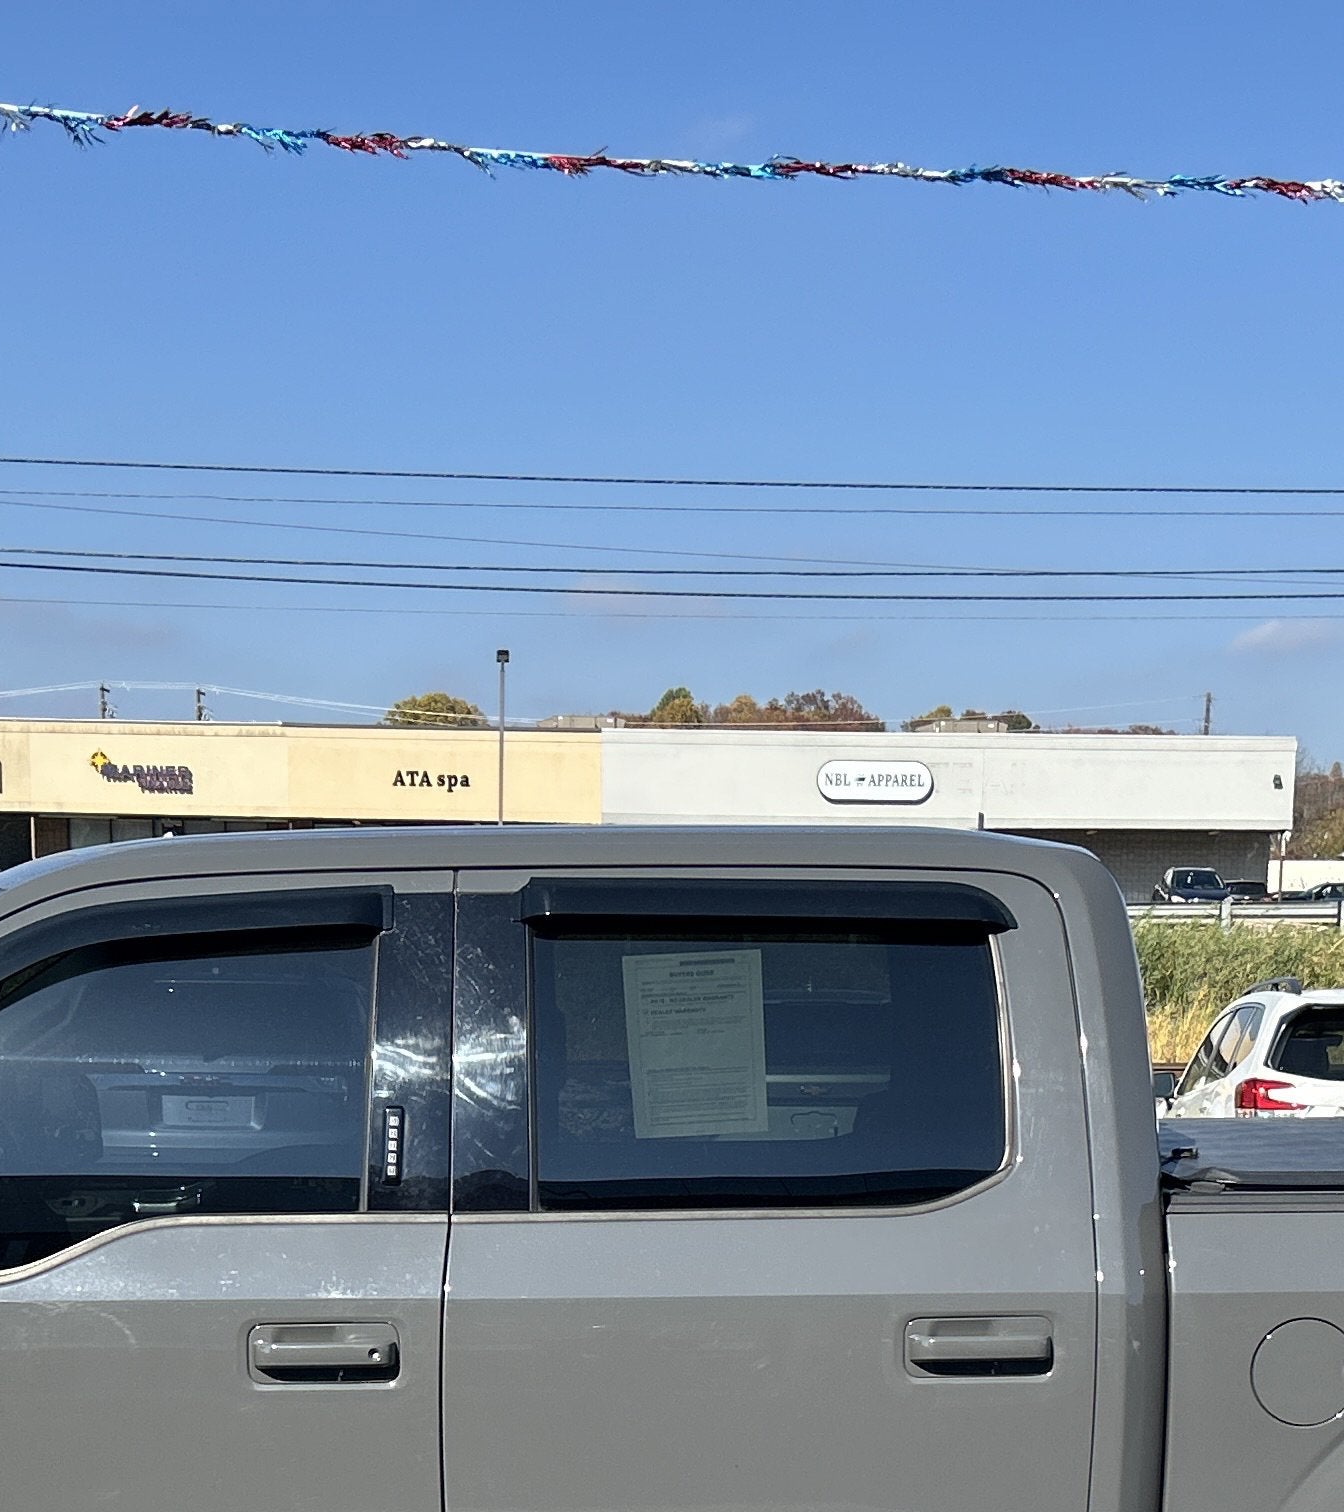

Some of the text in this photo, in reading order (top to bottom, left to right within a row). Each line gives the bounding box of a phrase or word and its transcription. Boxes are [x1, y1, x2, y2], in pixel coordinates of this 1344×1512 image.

[392, 770, 471, 793] ATA spa
[824, 773, 925, 788] NBL APPAREL
